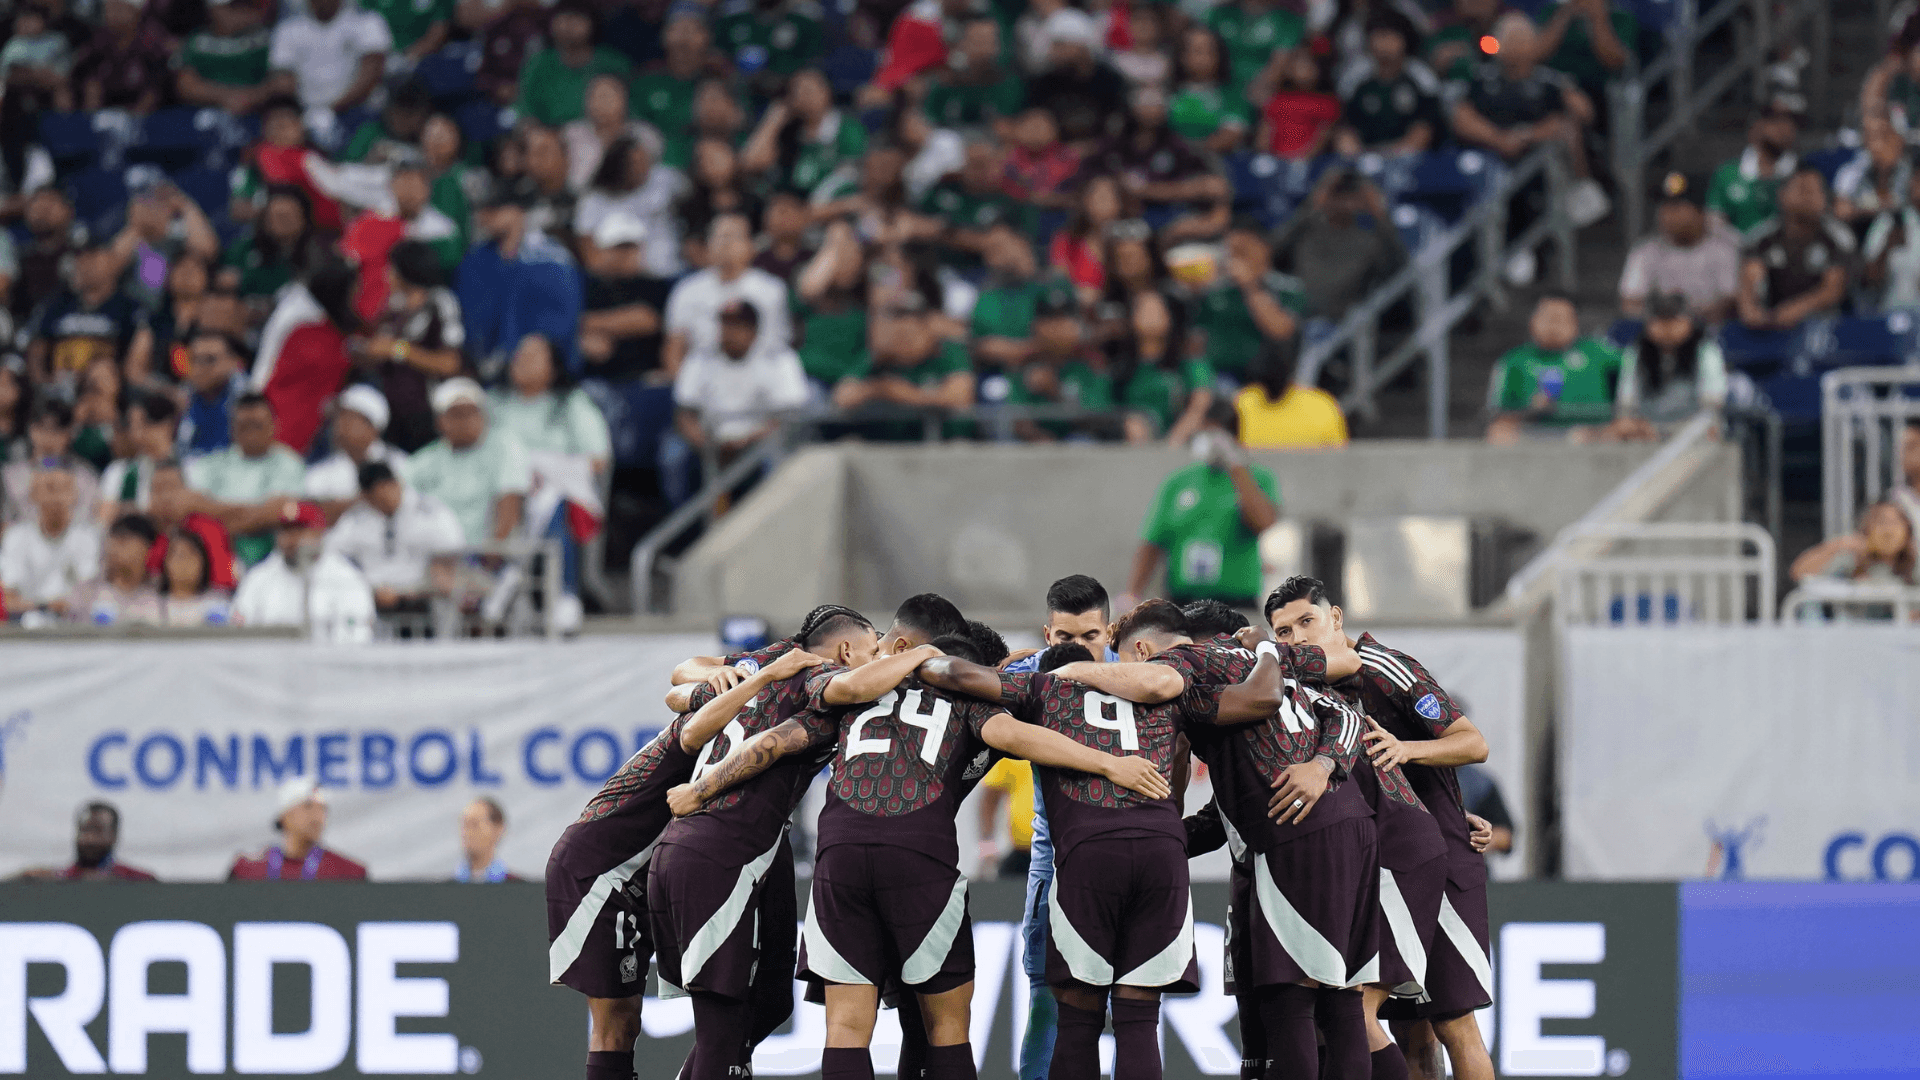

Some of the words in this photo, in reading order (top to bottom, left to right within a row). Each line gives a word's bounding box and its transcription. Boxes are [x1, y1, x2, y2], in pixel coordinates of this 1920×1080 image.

[845, 689, 952, 766] 24
[1084, 691, 1139, 751] 9
[87, 729, 503, 790] CONMEBOL
